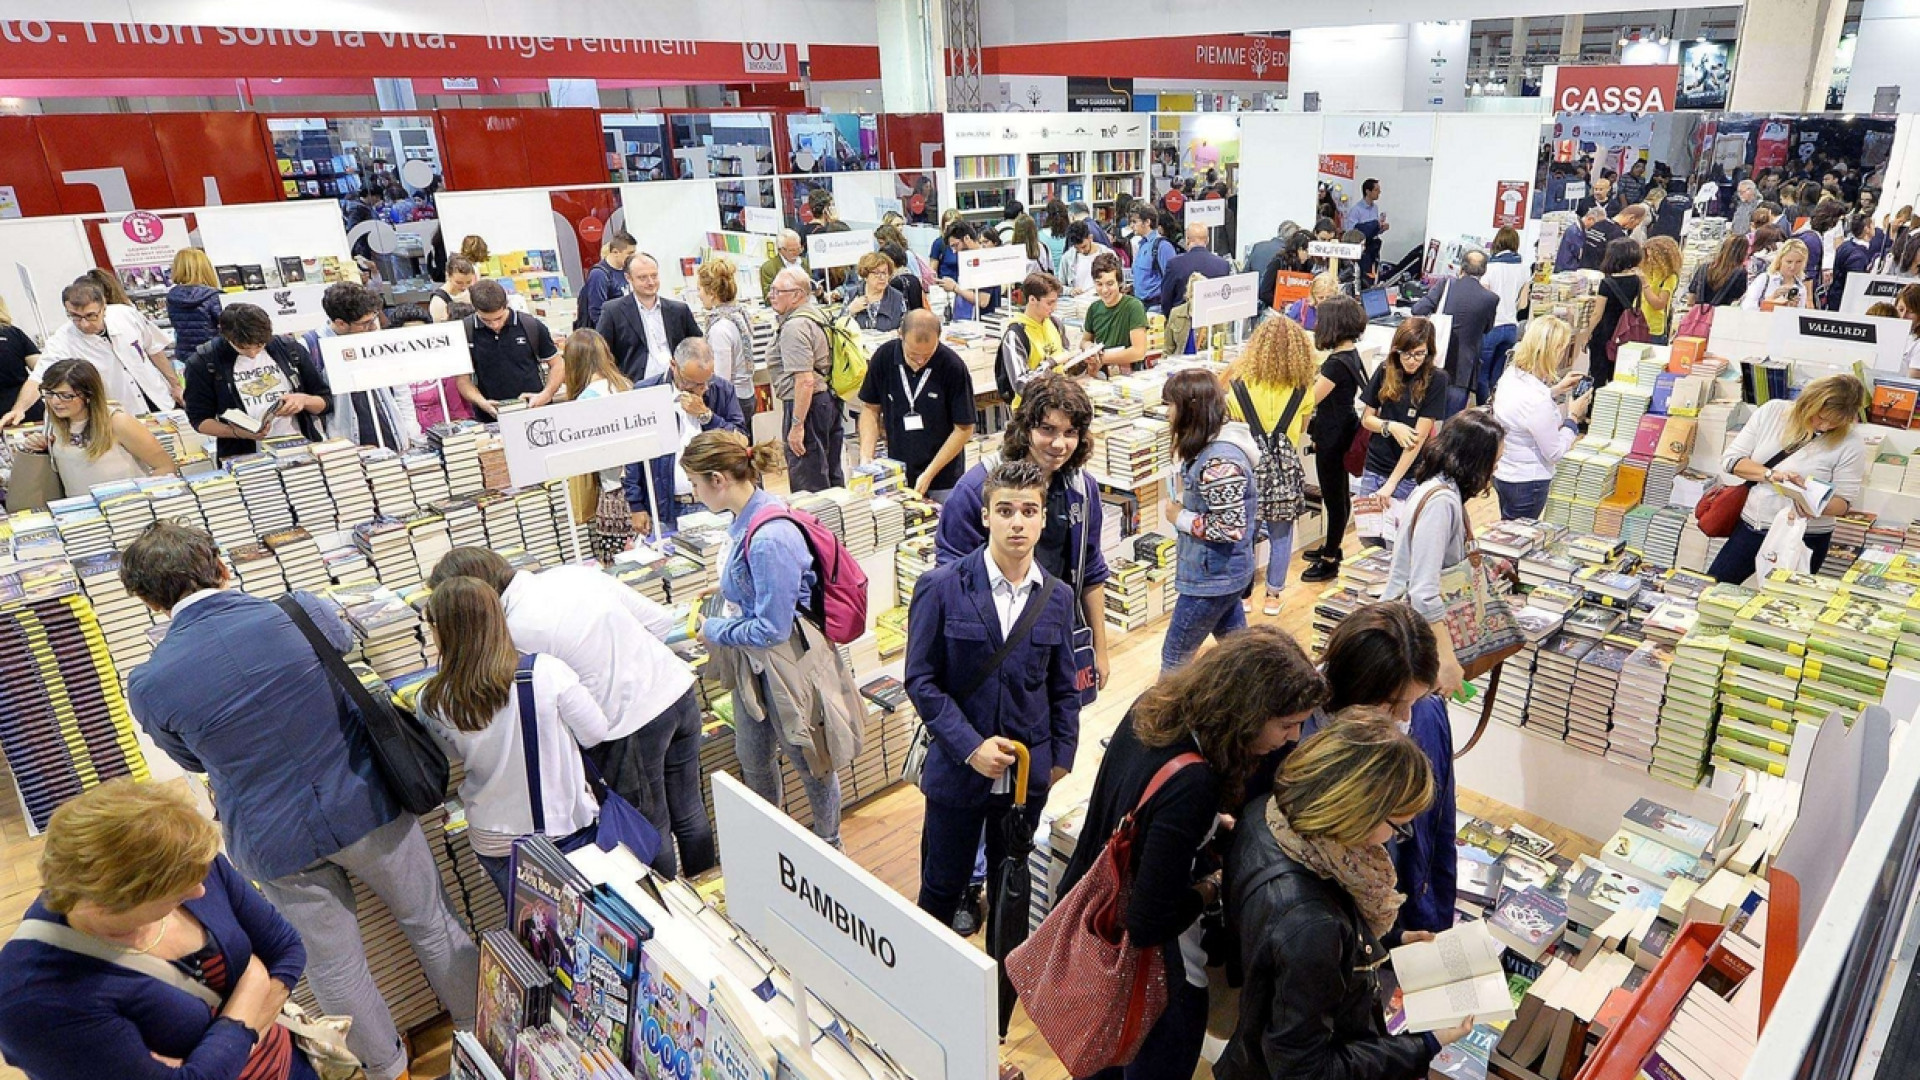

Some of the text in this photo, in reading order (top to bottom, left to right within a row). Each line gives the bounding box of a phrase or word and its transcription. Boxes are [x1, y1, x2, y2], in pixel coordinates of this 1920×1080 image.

[1196, 45, 1246, 65] PIEMME
[1561, 87, 1665, 118] CASSA
[1808, 322, 1867, 338] VALLARDI
[361, 334, 451, 358] LONGANESI
[558, 411, 657, 443] Garzanti Libri
[778, 852, 896, 968] BAMBINO
